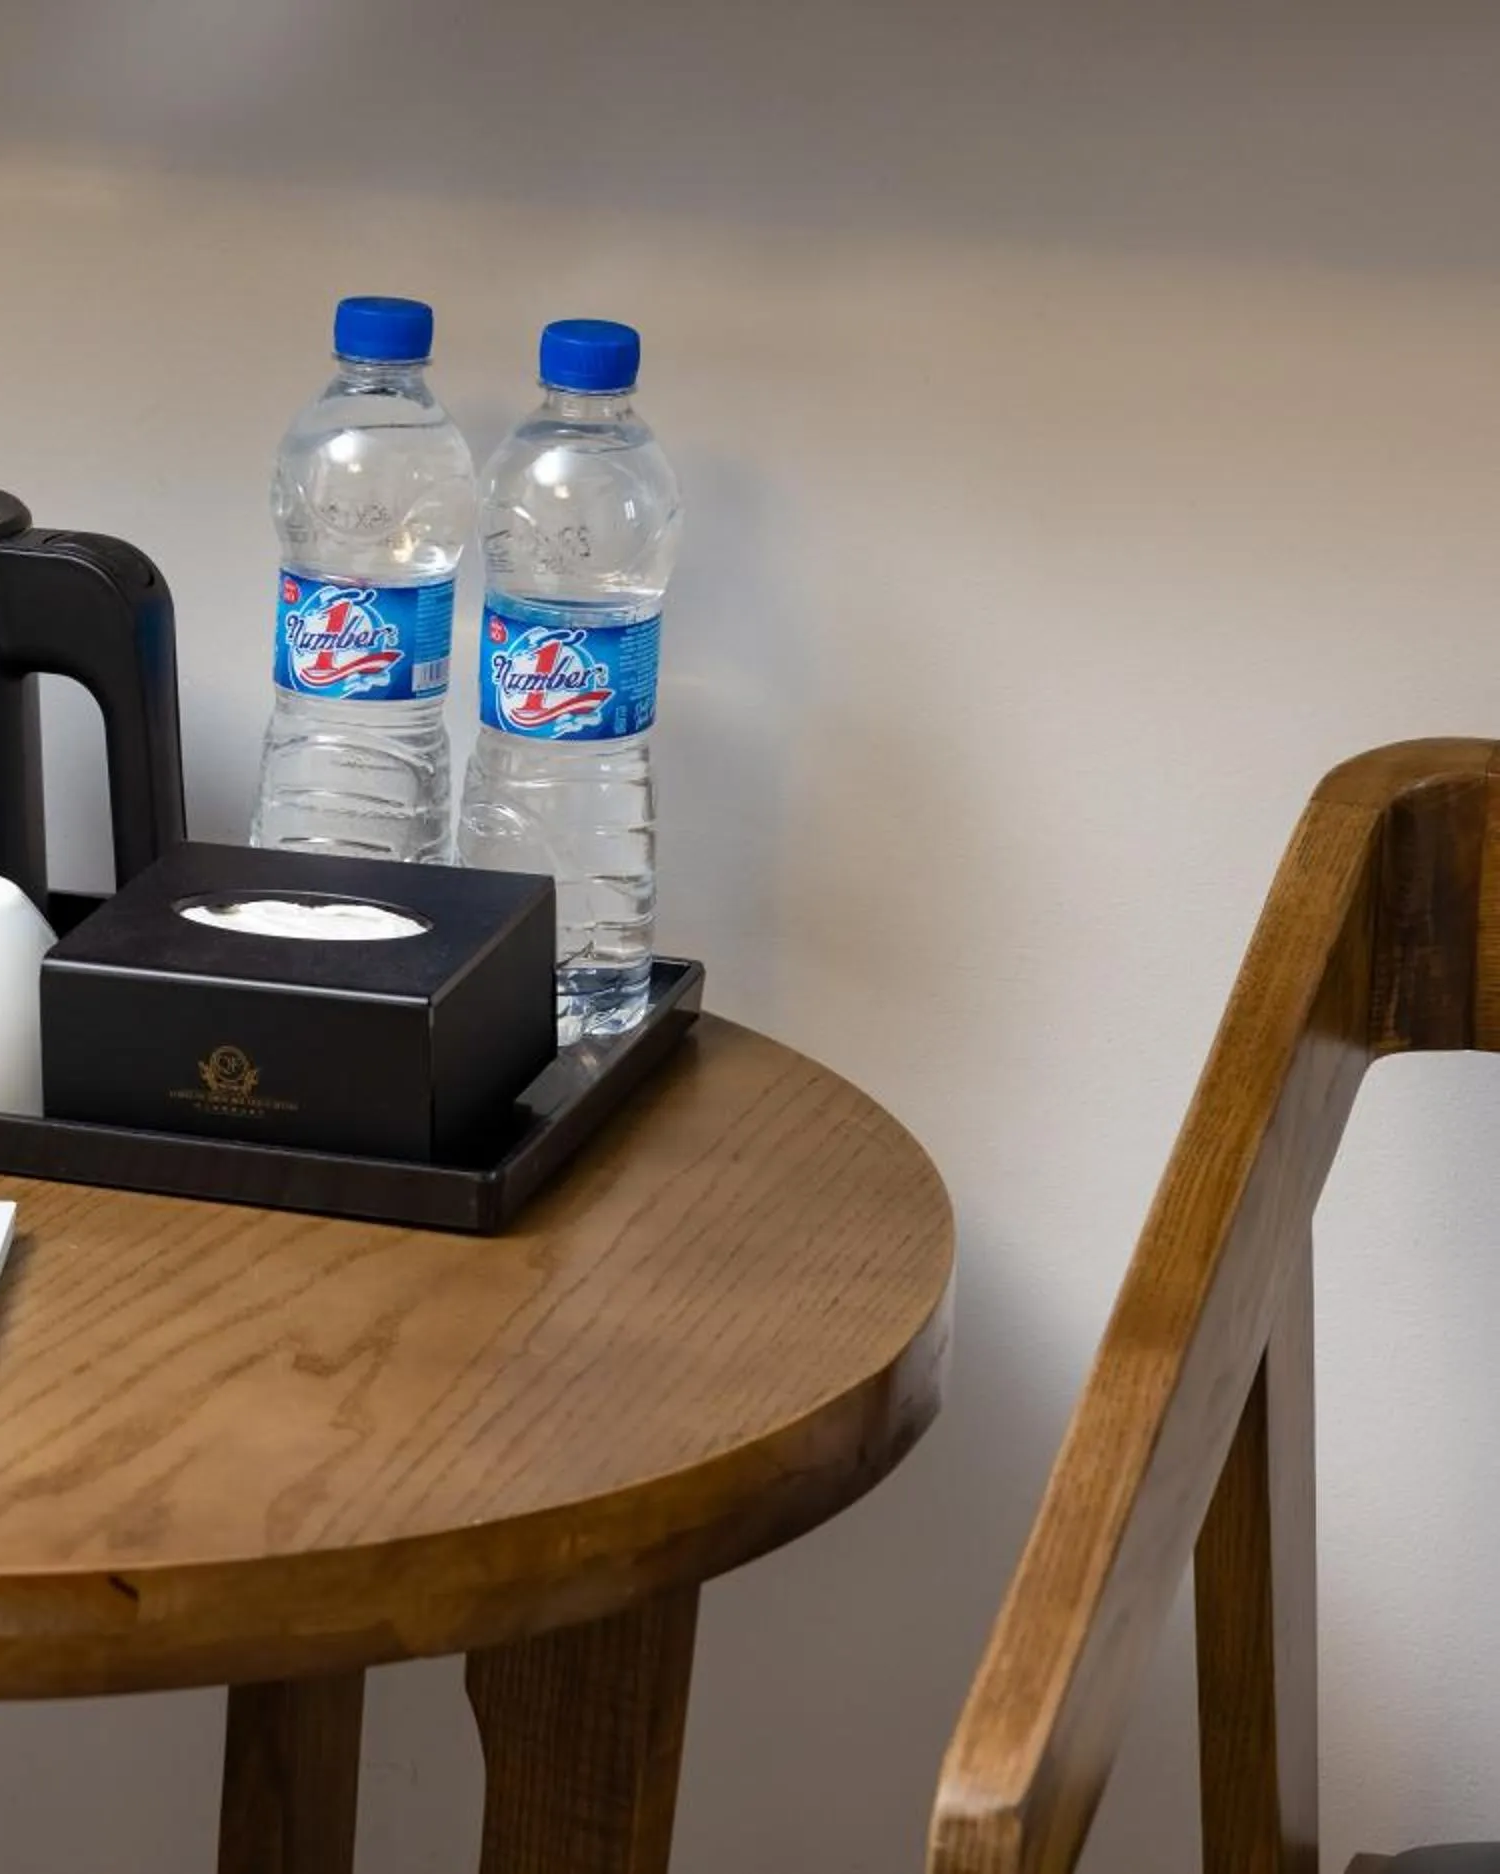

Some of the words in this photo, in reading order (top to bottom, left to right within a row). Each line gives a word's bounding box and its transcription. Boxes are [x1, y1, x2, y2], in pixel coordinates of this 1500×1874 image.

[287, 614, 386, 656] Number
[314, 601, 352, 670] 1
[492, 654, 593, 696] Number
[520, 640, 562, 711] 1
